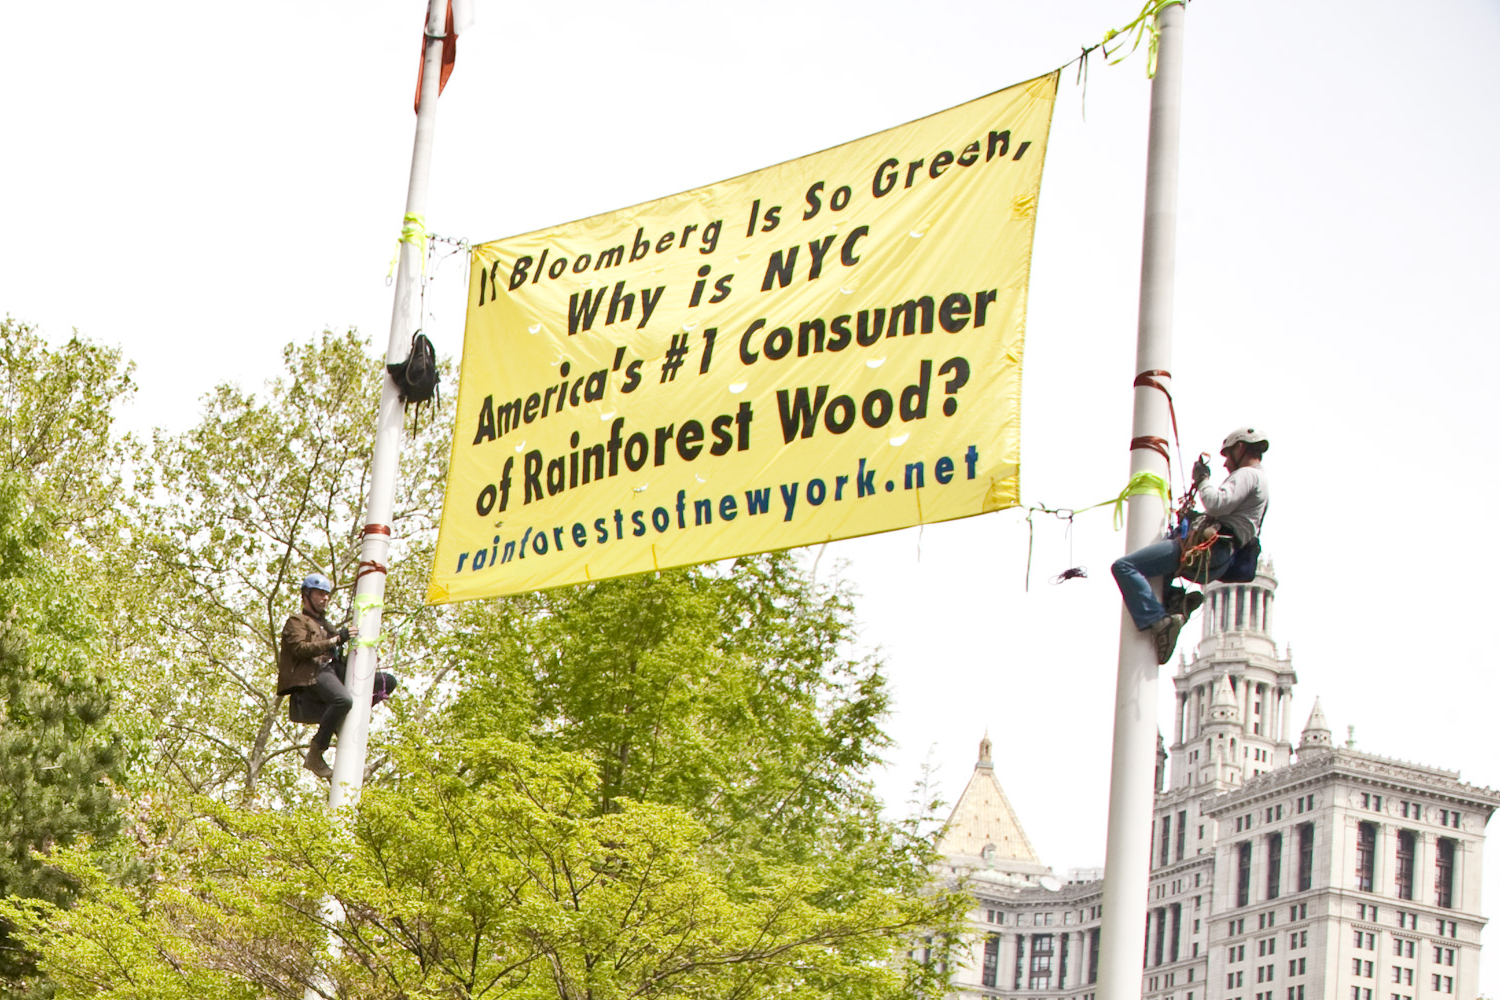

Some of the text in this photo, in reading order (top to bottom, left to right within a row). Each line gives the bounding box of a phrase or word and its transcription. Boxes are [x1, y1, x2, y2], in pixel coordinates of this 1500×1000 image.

[508, 219, 723, 291] Bloomberg
[747, 199, 781, 237] Is
[803, 181, 852, 220] So
[872, 129, 1032, 198] Green,
[566, 225, 870, 336] Why is NYC
[472, 288, 998, 445] America's #1 Consumer
[476, 356, 972, 517] of Rainforest Wood?
[456, 444, 979, 573] rainforestsofnewyork.net
